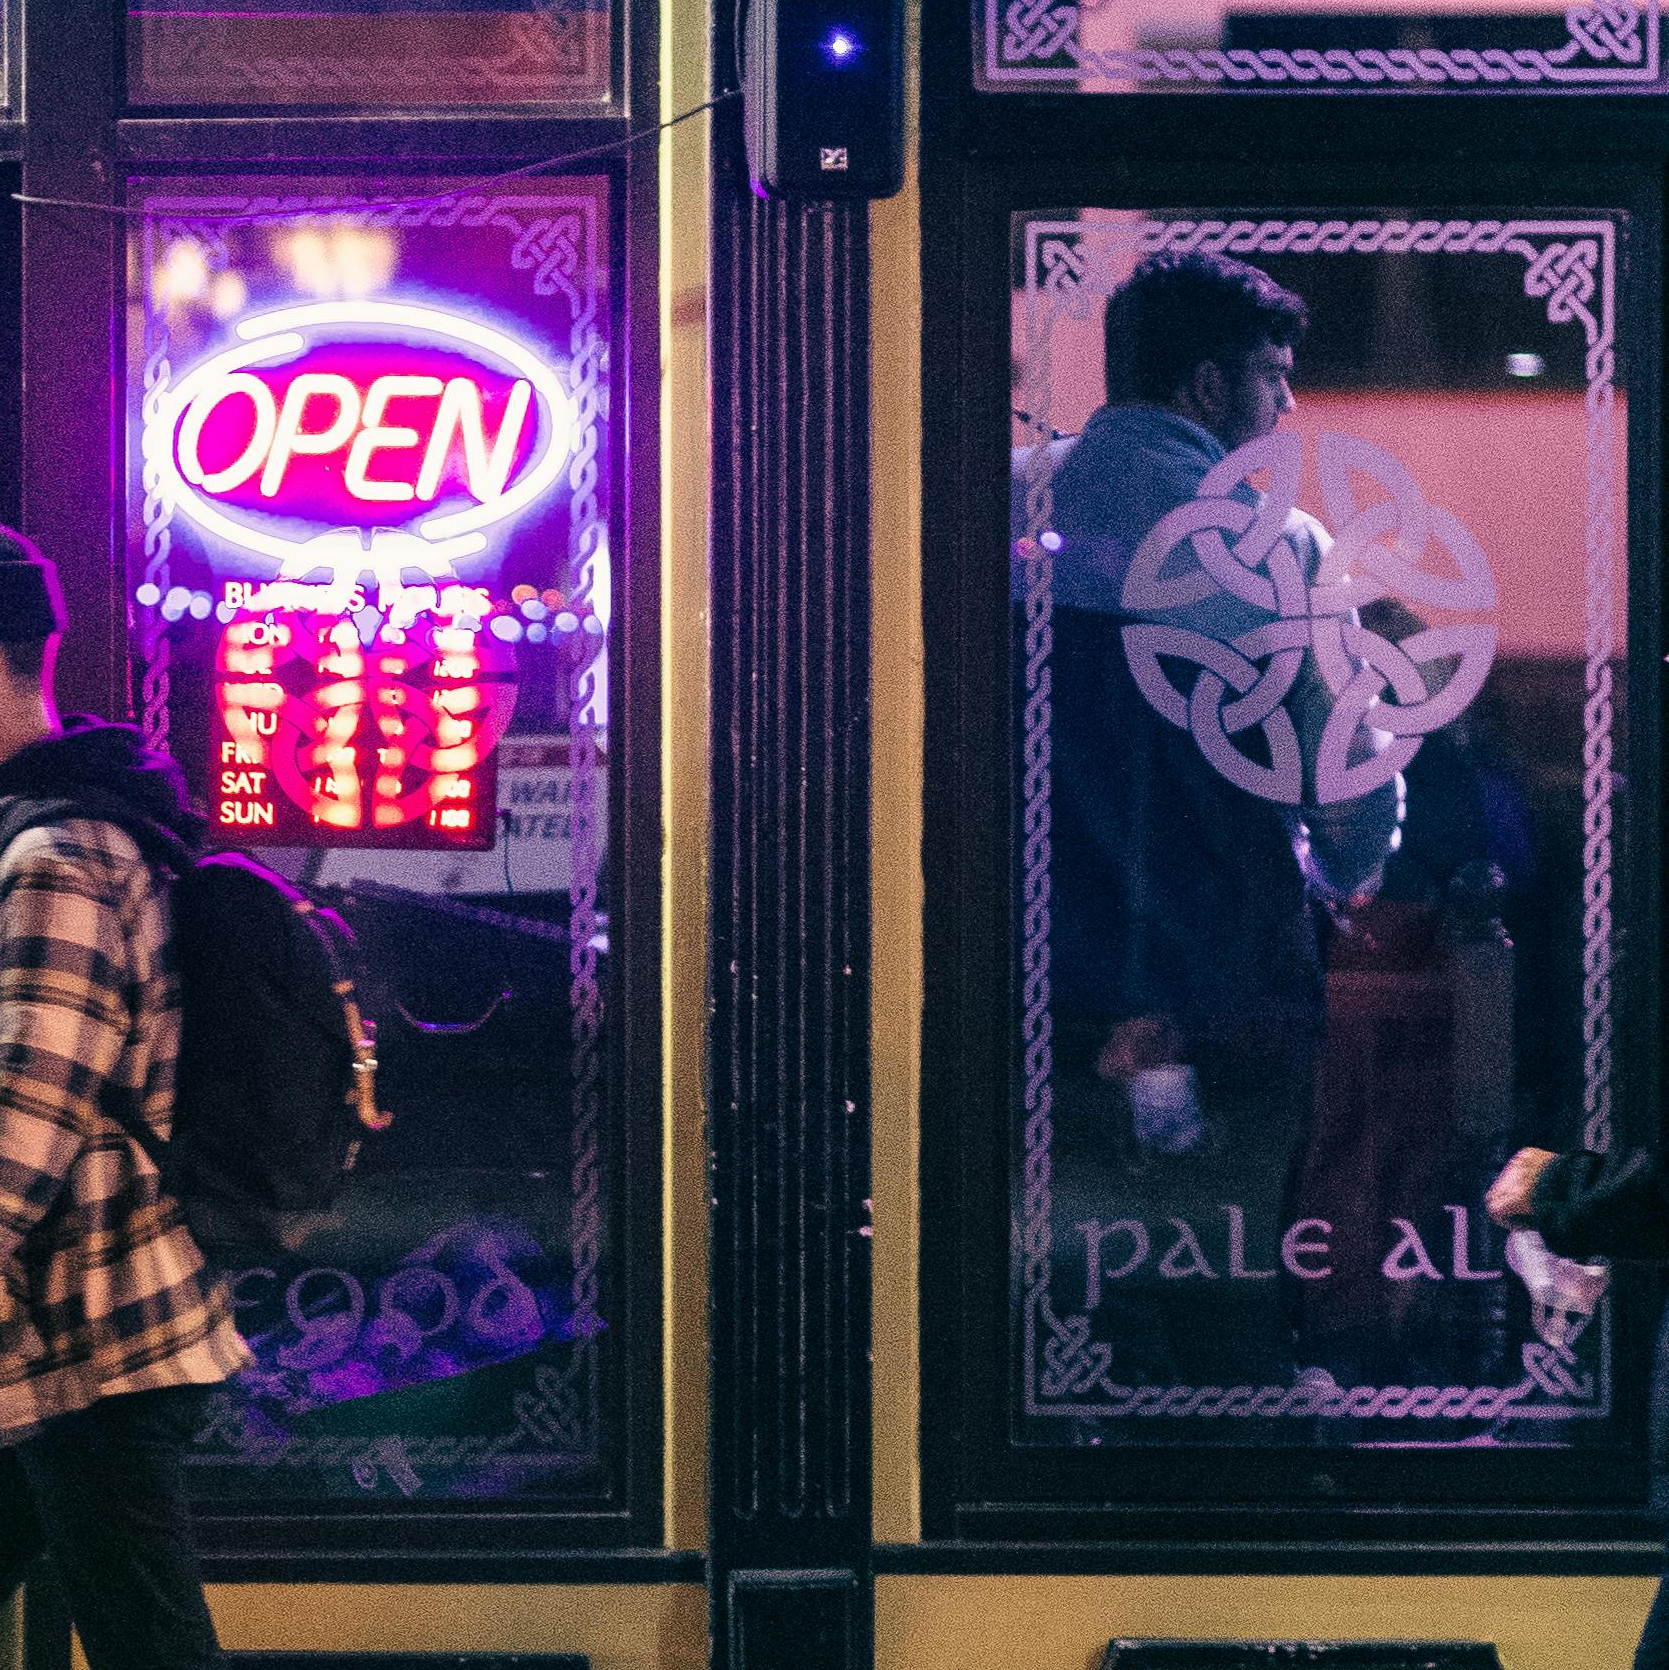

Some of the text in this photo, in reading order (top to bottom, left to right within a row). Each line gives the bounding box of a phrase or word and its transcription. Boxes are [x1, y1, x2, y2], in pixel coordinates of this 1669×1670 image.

[177, 372, 531, 502] OPEN
[220, 771, 266, 794] SAT
[219, 800, 274, 825] SUN
